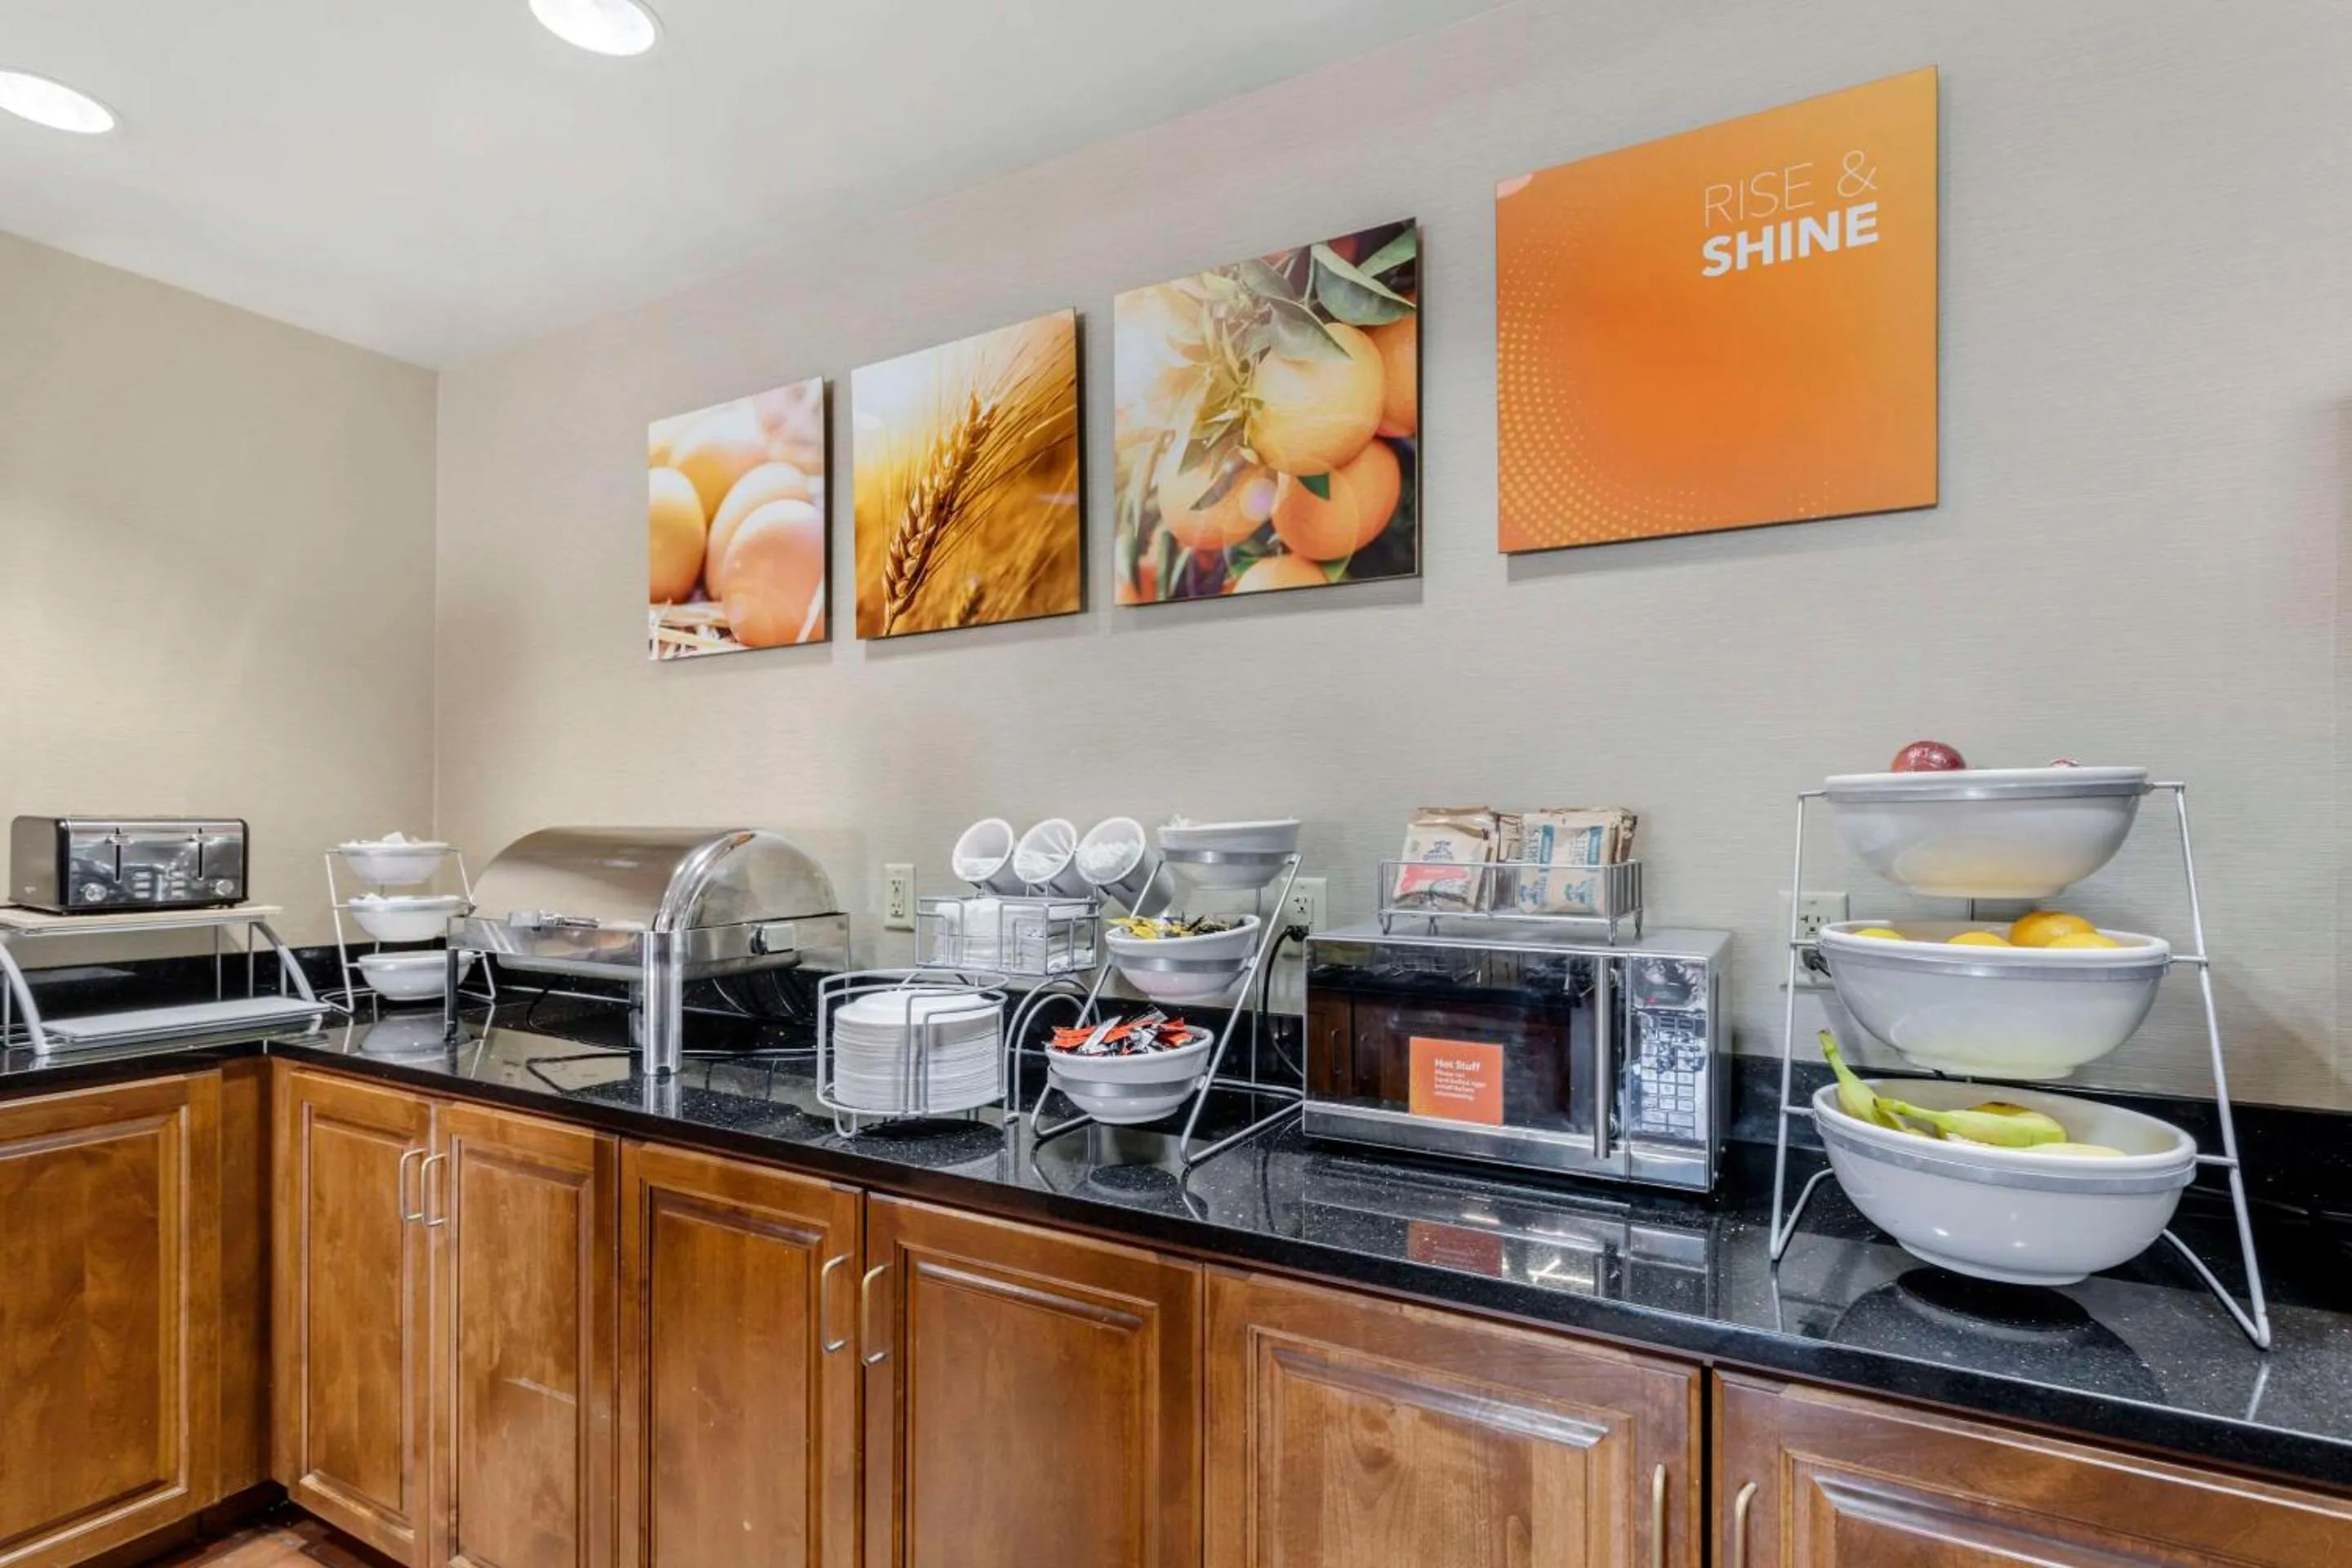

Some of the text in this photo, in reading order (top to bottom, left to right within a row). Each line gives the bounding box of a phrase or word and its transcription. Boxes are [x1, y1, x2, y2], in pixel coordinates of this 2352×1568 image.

[1704, 149, 1878, 229] RISE &
[1701, 201, 1880, 278] SHINE
